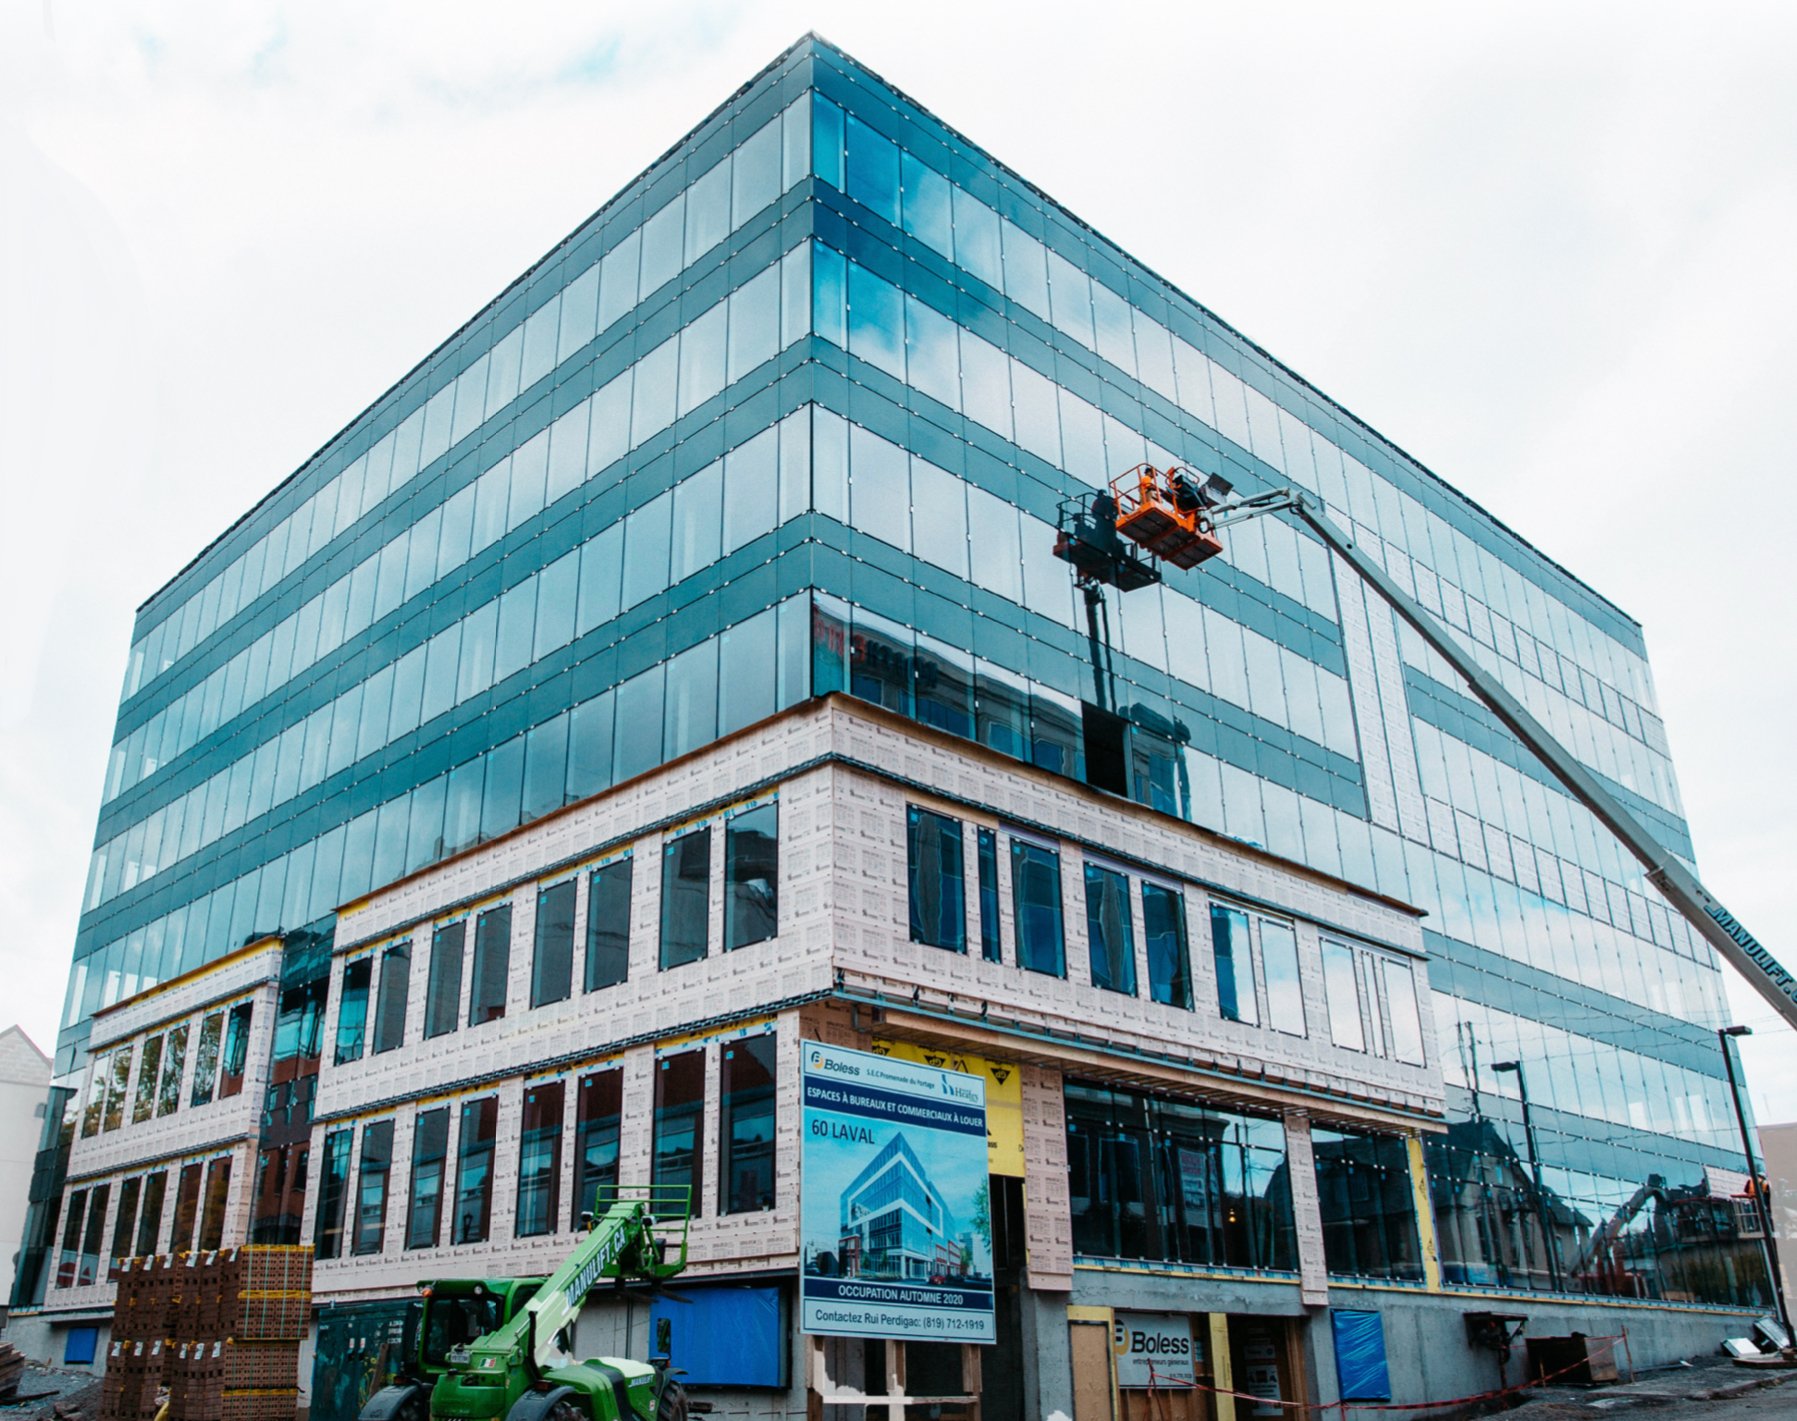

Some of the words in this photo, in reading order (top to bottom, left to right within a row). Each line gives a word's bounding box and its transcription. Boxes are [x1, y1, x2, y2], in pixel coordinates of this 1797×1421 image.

[824, 1058, 860, 1076] Boless
[880, 1071, 908, 1083] Promenade
[807, 1086, 841, 1102] ESPACES
[842, 1090, 849, 1104] À
[849, 1094, 886, 1111] BUREAUX
[887, 1102, 896, 1112] ET
[897, 1103, 952, 1122] COMMERCIAUX
[953, 1111, 960, 1123] À
[960, 1116, 984, 1128] LOUER
[812, 1119, 828, 1137] 60
[833, 1122, 875, 1144] LAVAL
[562, 1226, 626, 1314] MANULIFT.CA
[838, 1284, 898, 1300] OCCUPATION
[900, 1290, 942, 1304] AUTOMNE
[943, 1294, 964, 1305] 2020
[816, 1309, 863, 1323] Contactez
[865, 1313, 879, 1324] Rui
[923, 1317, 944, 1330] (819)
[947, 1318, 984, 1330] 712-1919
[1131, 1331, 1189, 1354] Boless
